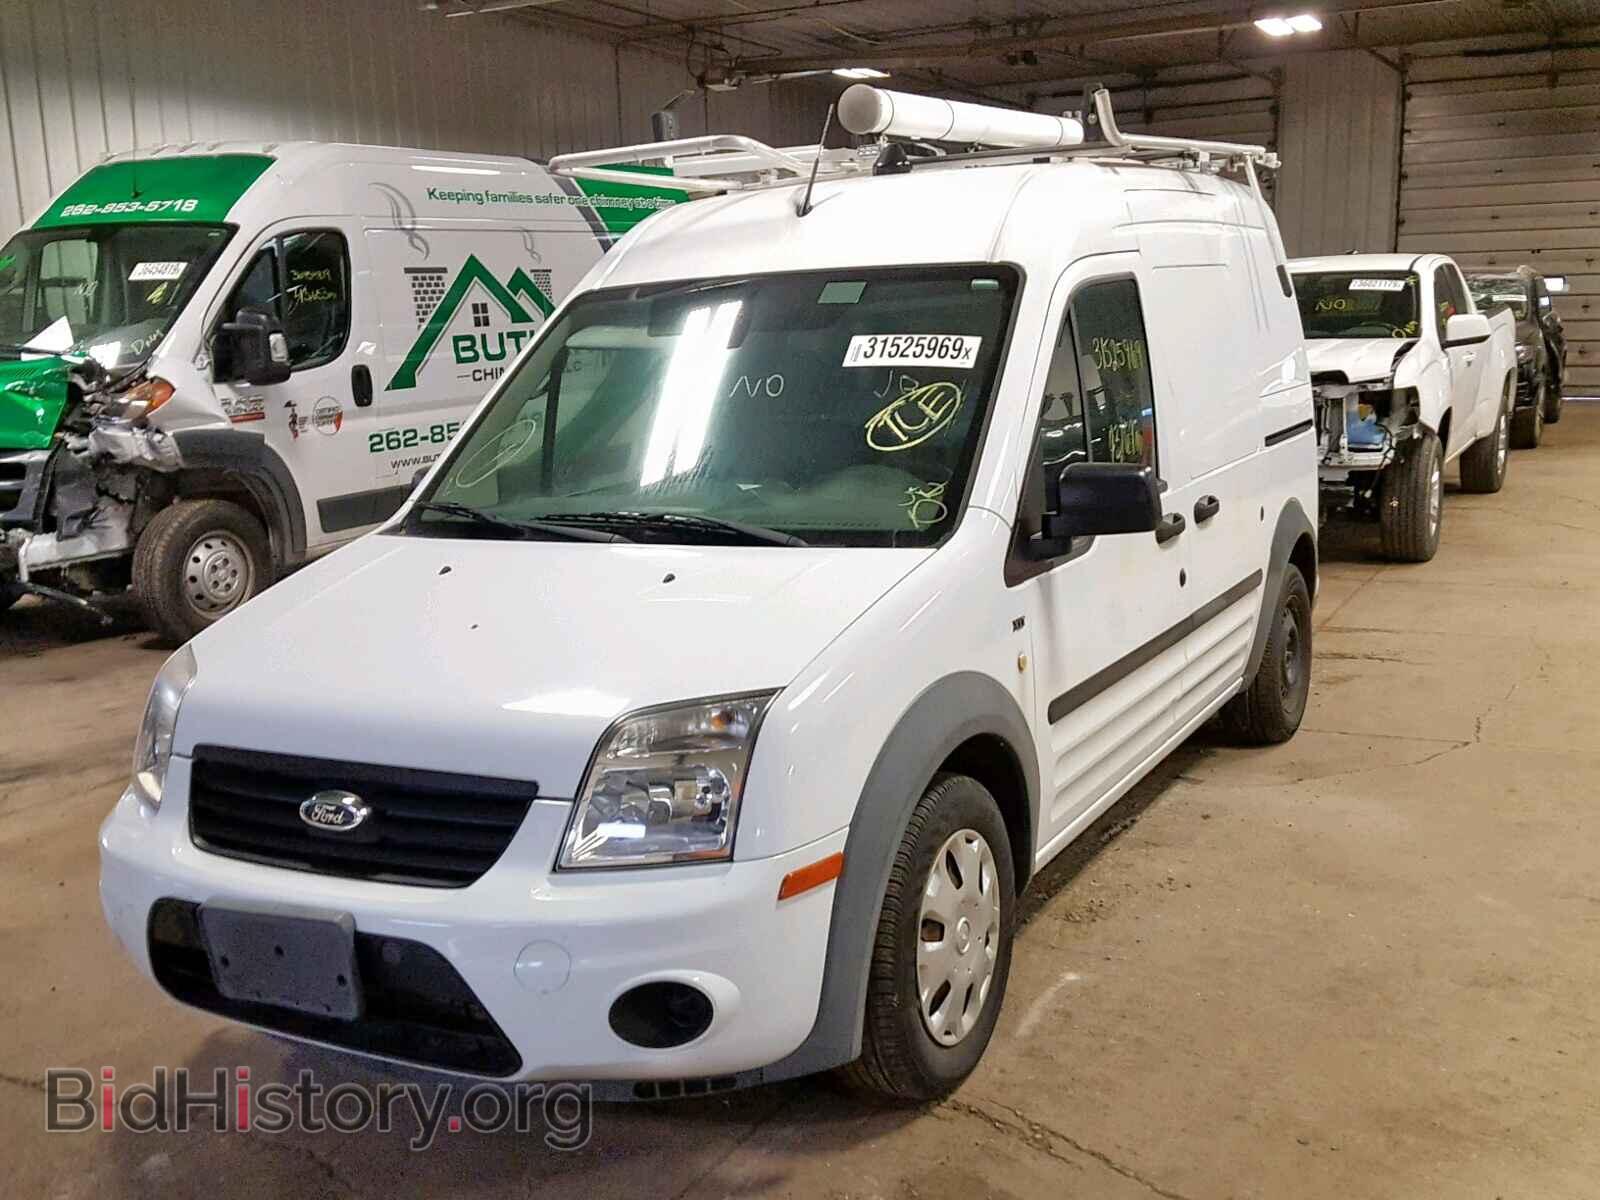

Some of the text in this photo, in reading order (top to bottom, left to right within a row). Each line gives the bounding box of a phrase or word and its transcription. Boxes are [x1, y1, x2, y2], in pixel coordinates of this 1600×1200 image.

[426, 187, 484, 206] Keeping
[484, 190, 533, 205] families
[534, 192, 567, 206] safer
[452, 329, 535, 364] BUT
[729, 374, 785, 398] NO
[367, 420, 466, 454] 262-85
[311, 804, 345, 825] Ford
